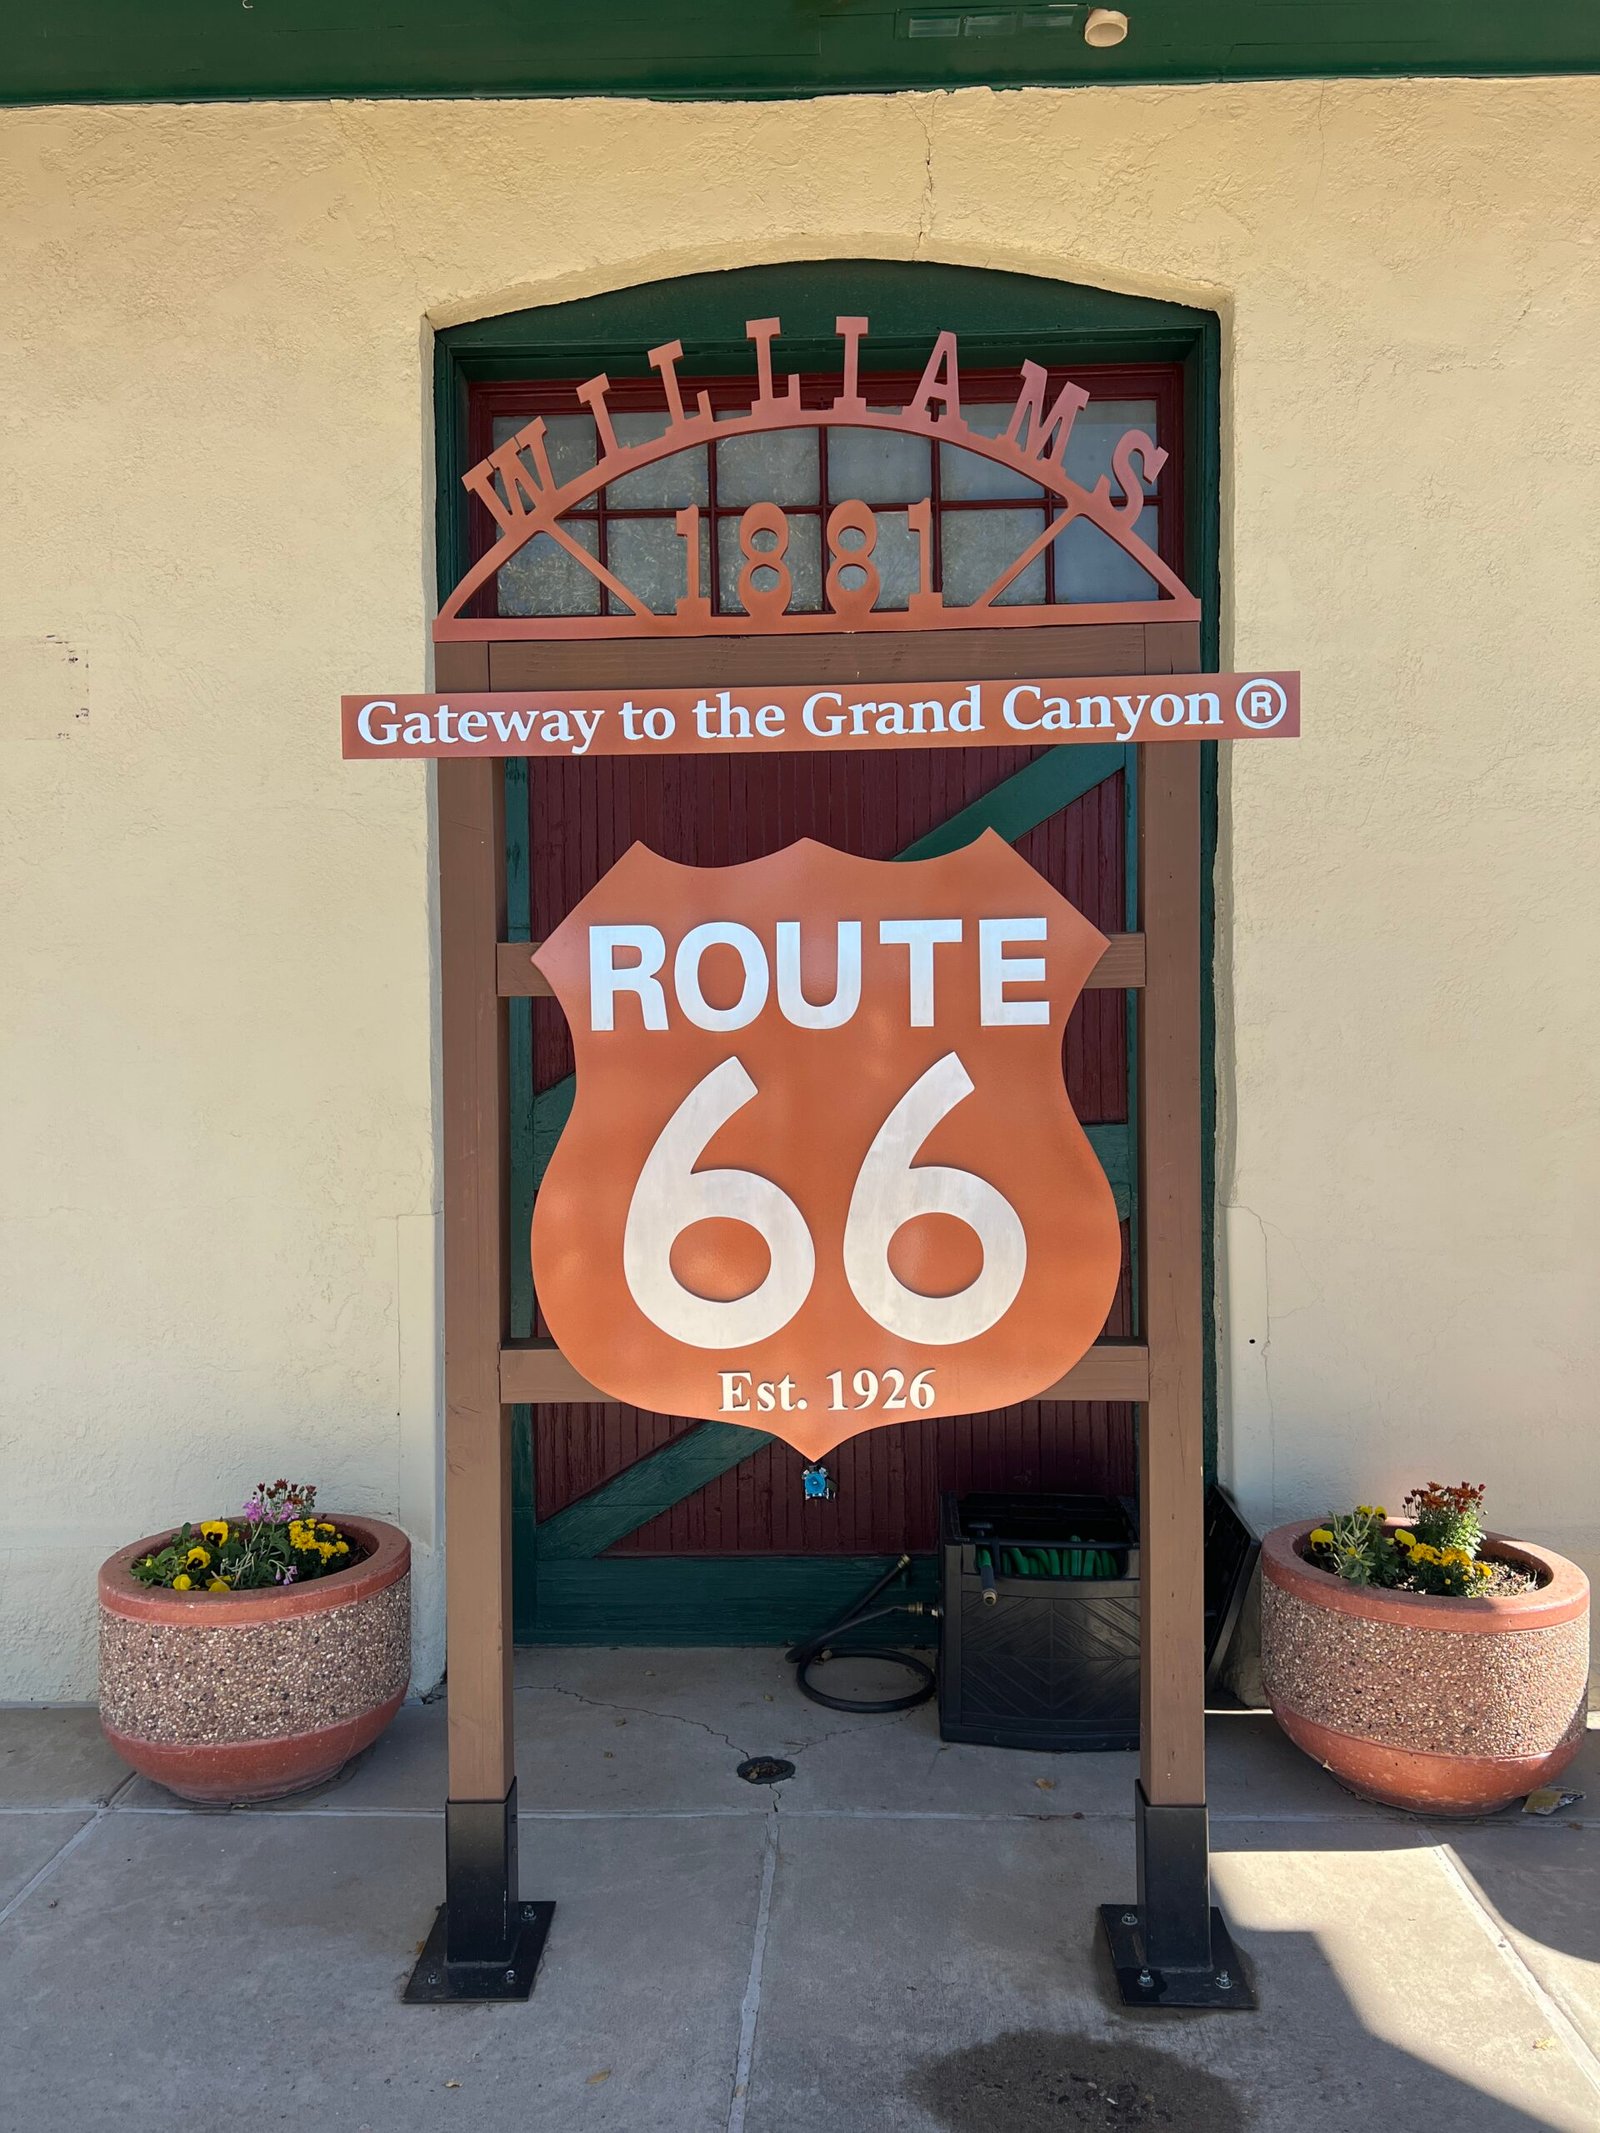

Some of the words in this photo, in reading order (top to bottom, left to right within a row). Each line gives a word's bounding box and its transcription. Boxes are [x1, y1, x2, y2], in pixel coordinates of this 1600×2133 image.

[462, 316, 1169, 527] WILLIAMS
[676, 498, 944, 617] 1881
[357, 700, 605, 755] Gateway
[618, 702, 675, 740] to
[692, 692, 785, 738] the
[803, 685, 985, 736] Grand
[1003, 685, 1223, 741] Canyon
[589, 917, 1050, 1032] ROUTE
[623, 1052, 1028, 1349] 66
[718, 1371, 808, 1412] Est.
[826, 1368, 938, 1410] 1926
